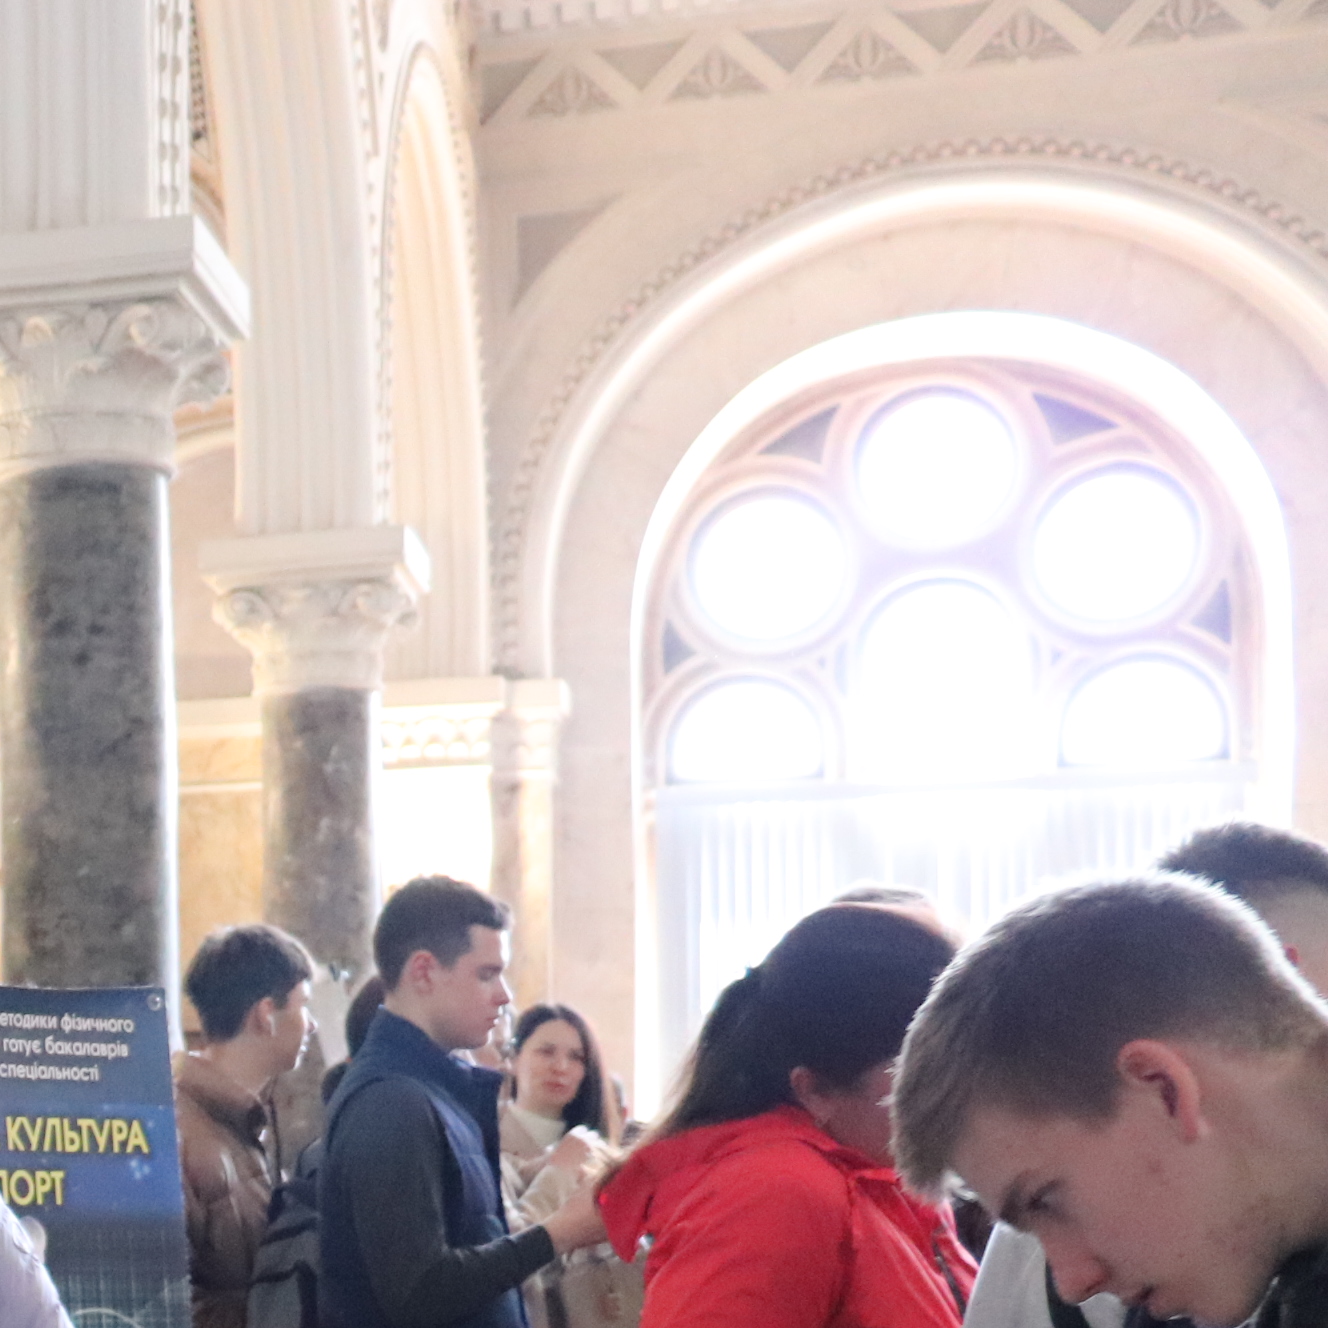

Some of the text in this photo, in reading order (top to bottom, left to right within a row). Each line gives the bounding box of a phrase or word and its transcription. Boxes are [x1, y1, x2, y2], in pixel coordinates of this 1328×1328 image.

[61, 1013, 134, 1033] фізичного
[3, 1037, 42, 1056] готує
[44, 1035, 129, 1059] бакалаврів
[5, 1116, 150, 1153] КУЛЬТУРА
